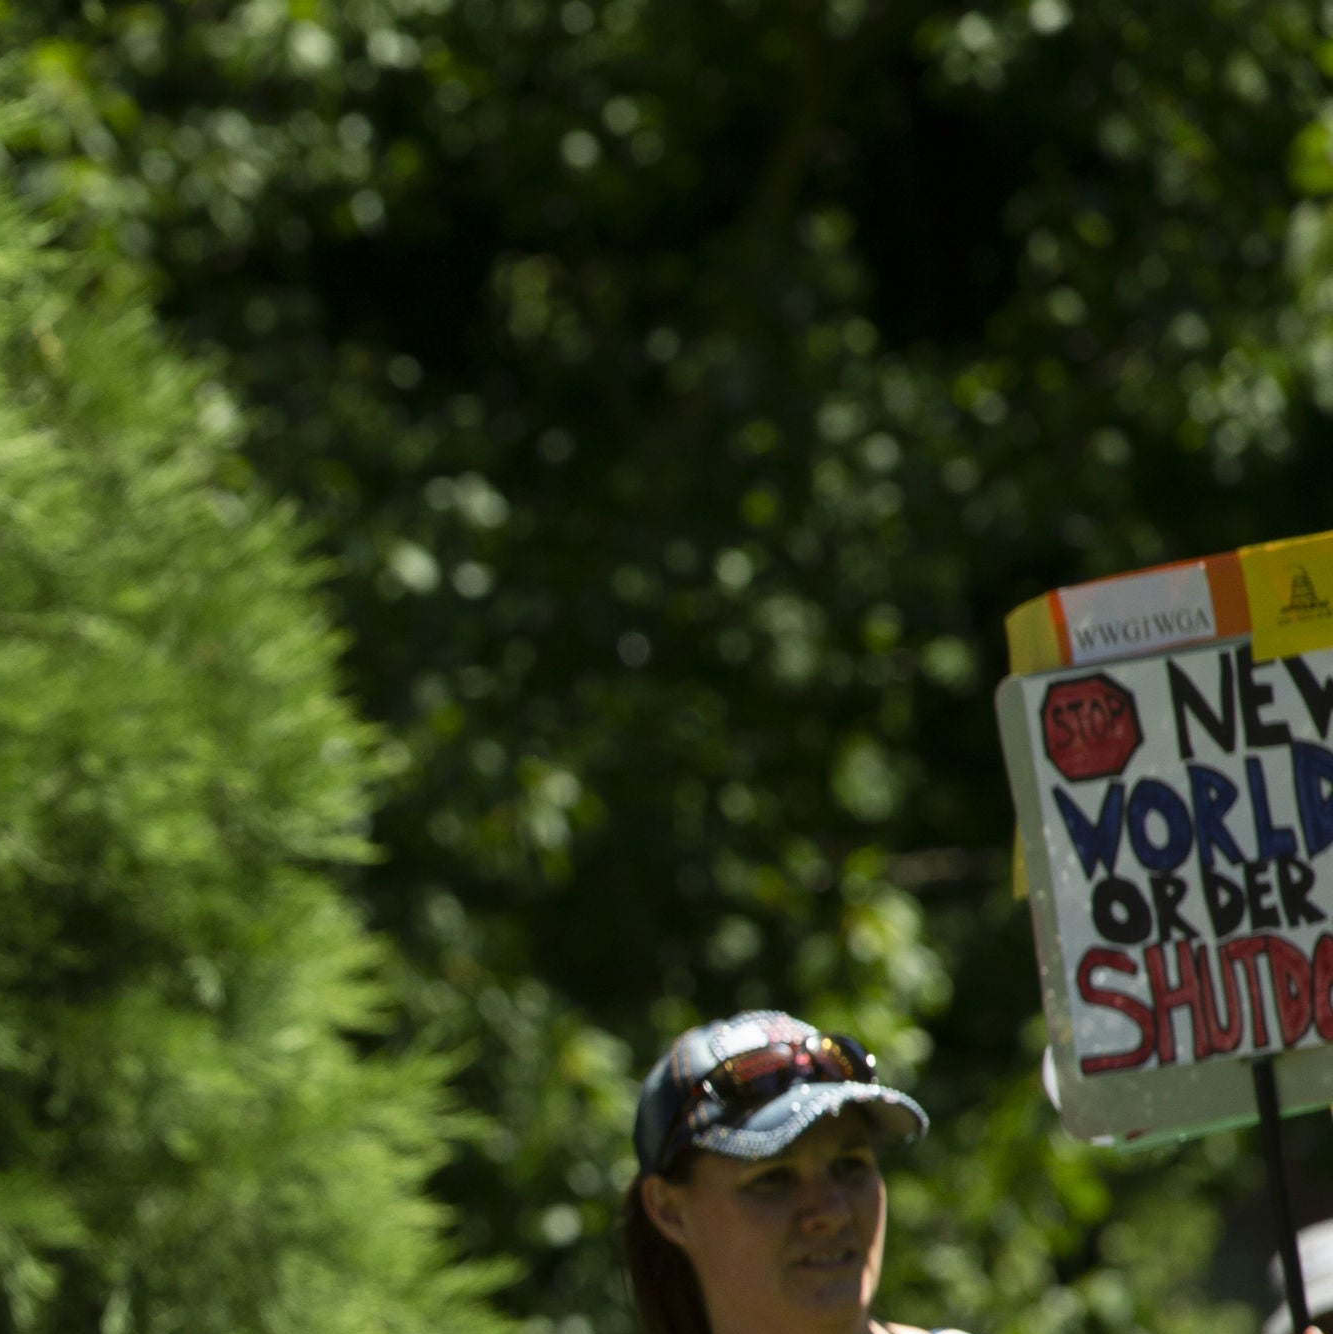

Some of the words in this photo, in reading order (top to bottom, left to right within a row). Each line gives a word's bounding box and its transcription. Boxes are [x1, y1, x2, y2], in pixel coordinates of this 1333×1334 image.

[1052, 691, 1125, 748] STOP
[1052, 738, 1333, 880] WORLD
[1091, 854, 1327, 945] ORDER
